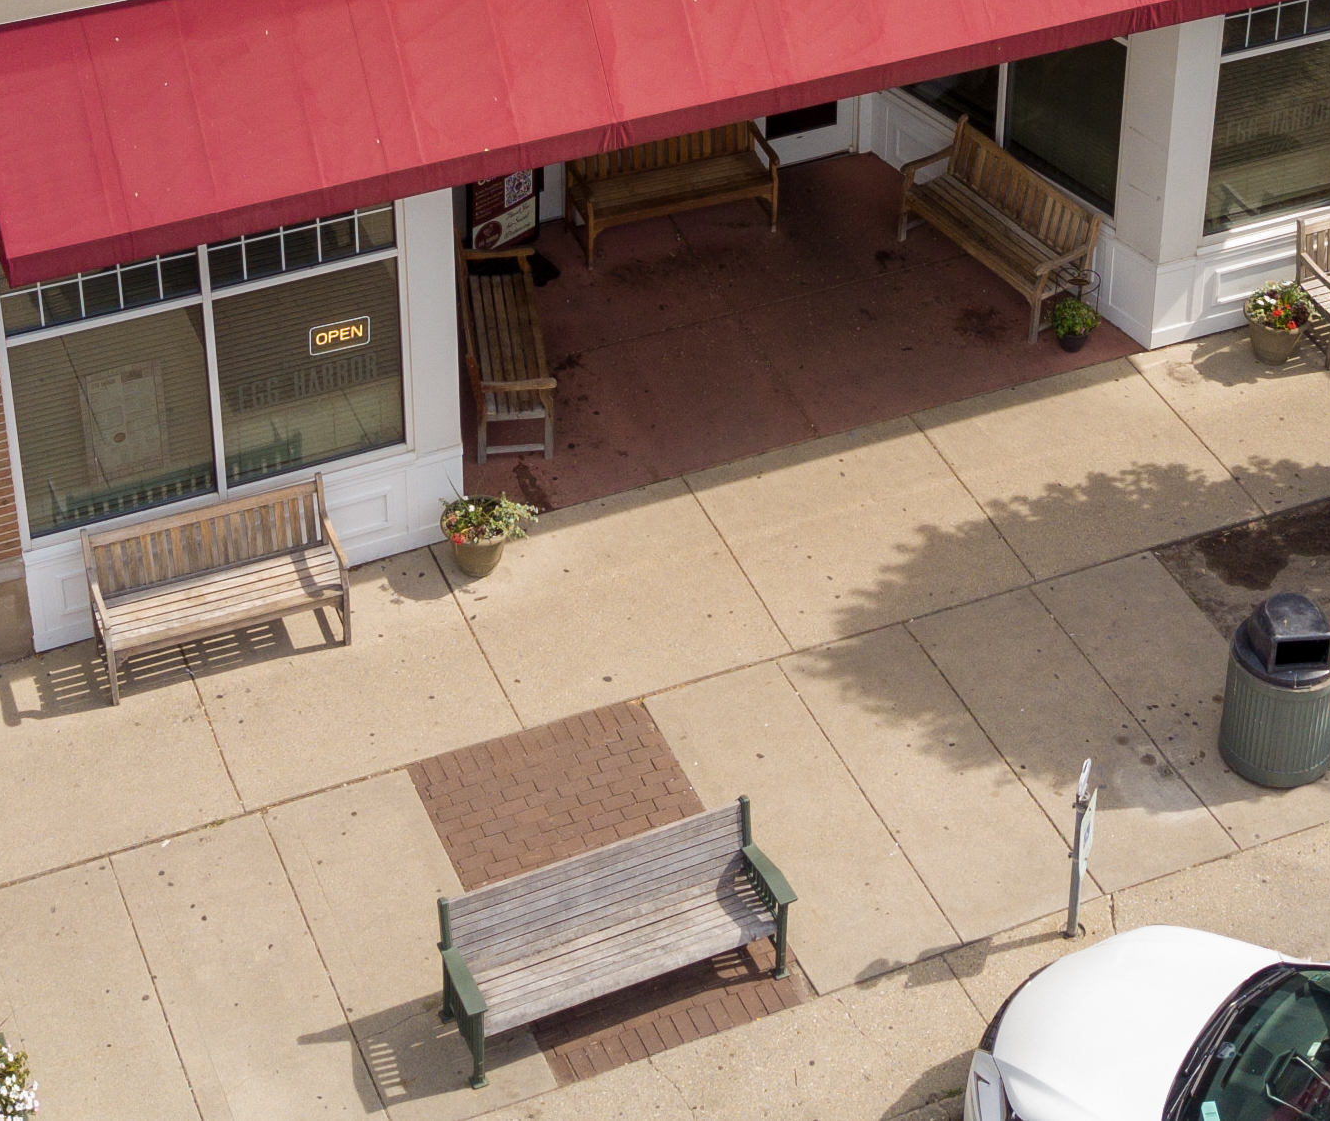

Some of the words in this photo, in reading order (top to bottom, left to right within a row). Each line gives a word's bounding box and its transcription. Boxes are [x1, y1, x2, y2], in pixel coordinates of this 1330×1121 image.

[316, 324, 363, 345] OPEN
[238, 377, 280, 411] EGG
[293, 353, 377, 397] HARBOR
